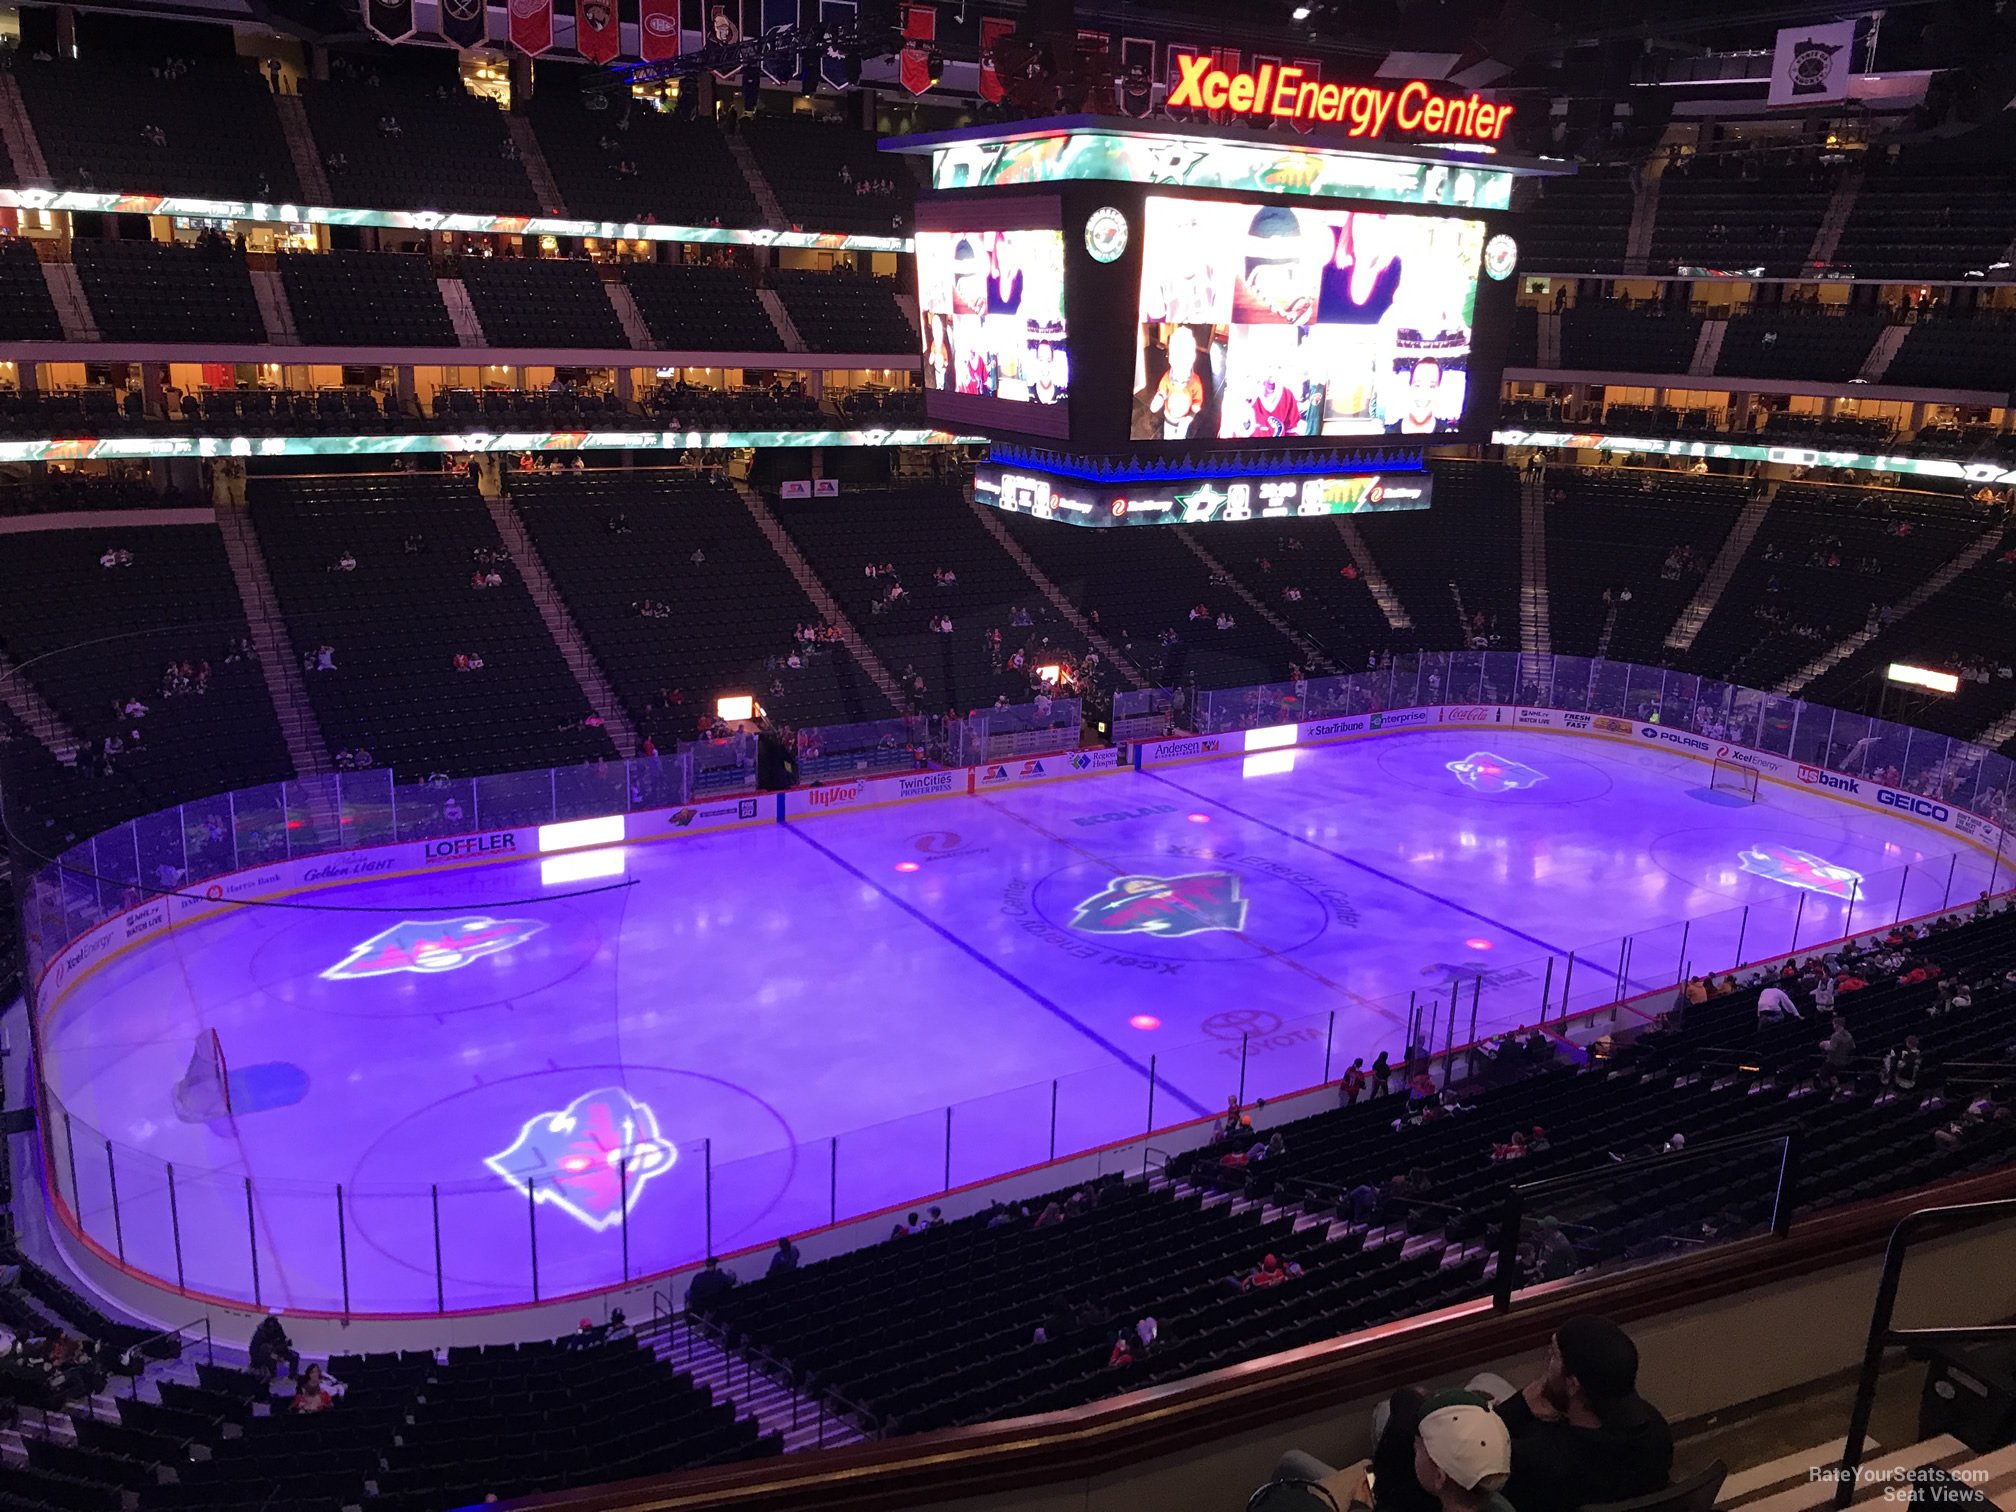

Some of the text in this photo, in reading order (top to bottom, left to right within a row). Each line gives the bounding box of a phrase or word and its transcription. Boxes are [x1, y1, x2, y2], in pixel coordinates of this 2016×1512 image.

[1167, 54, 1514, 140] Xcel Energy Center
[1564, 713, 1591, 722] FRESH
[1315, 720, 1364, 735] StarTribune
[1155, 741, 1199, 755] Andersen
[1660, 732, 1709, 751] POLARIS
[899, 774, 952, 789] TwinCities
[900, 784, 952, 797] PIONEER PRESS
[1877, 789, 1949, 822] GEICO
[1071, 804, 1179, 827] ECOLAB
[425, 833, 516, 858] LOFFLER
[353, 859, 395, 875] LIGHT
[257, 873, 281, 885] Bank
[1000, 877, 1186, 976] Xcel Energy Center
[1218, 1027, 1326, 1061] TOYOTA
